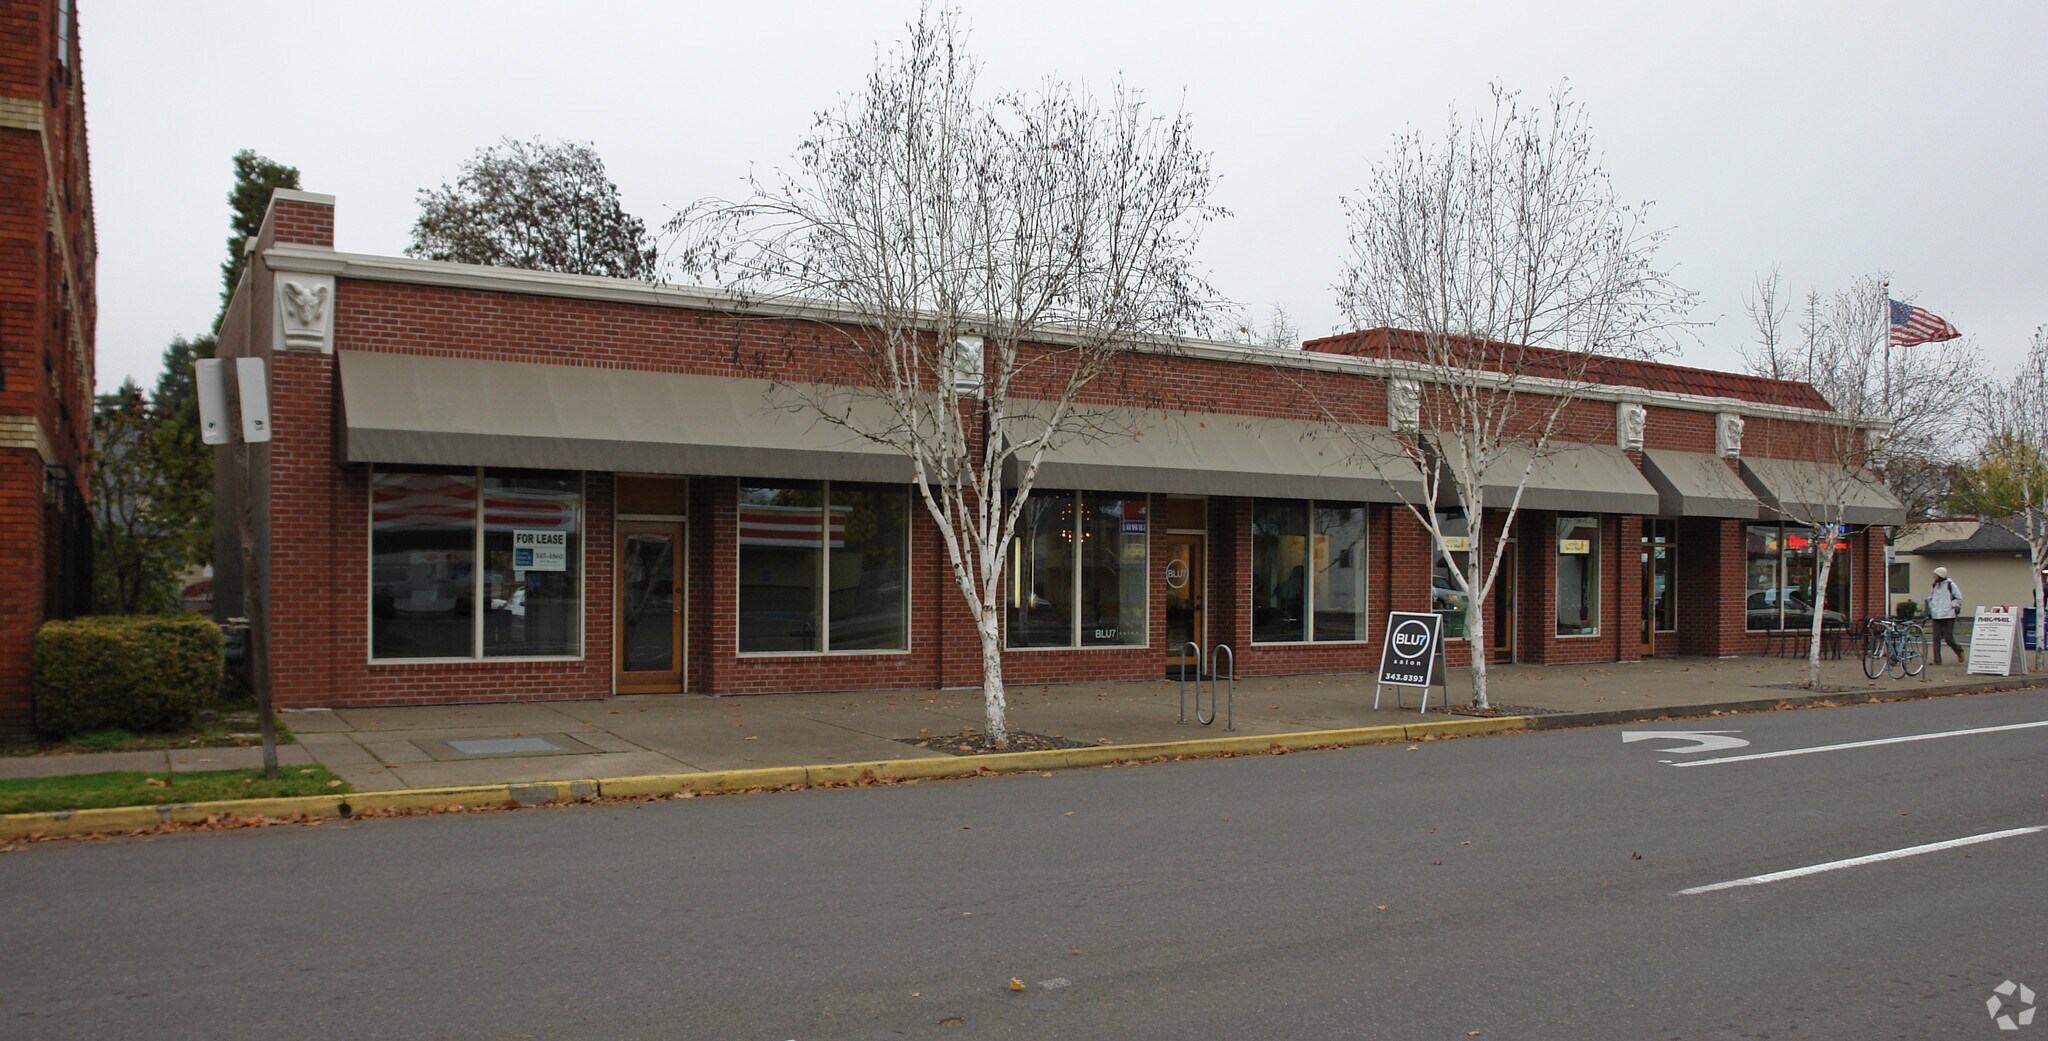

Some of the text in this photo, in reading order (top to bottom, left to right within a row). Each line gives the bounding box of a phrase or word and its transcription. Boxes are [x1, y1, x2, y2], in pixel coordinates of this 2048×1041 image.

[516, 533, 564, 545] FOR LEASE
[1095, 629, 1117, 639] BLU7
[1396, 633, 1427, 646] BLU7
[1385, 672, 1424, 683] 343.8393
